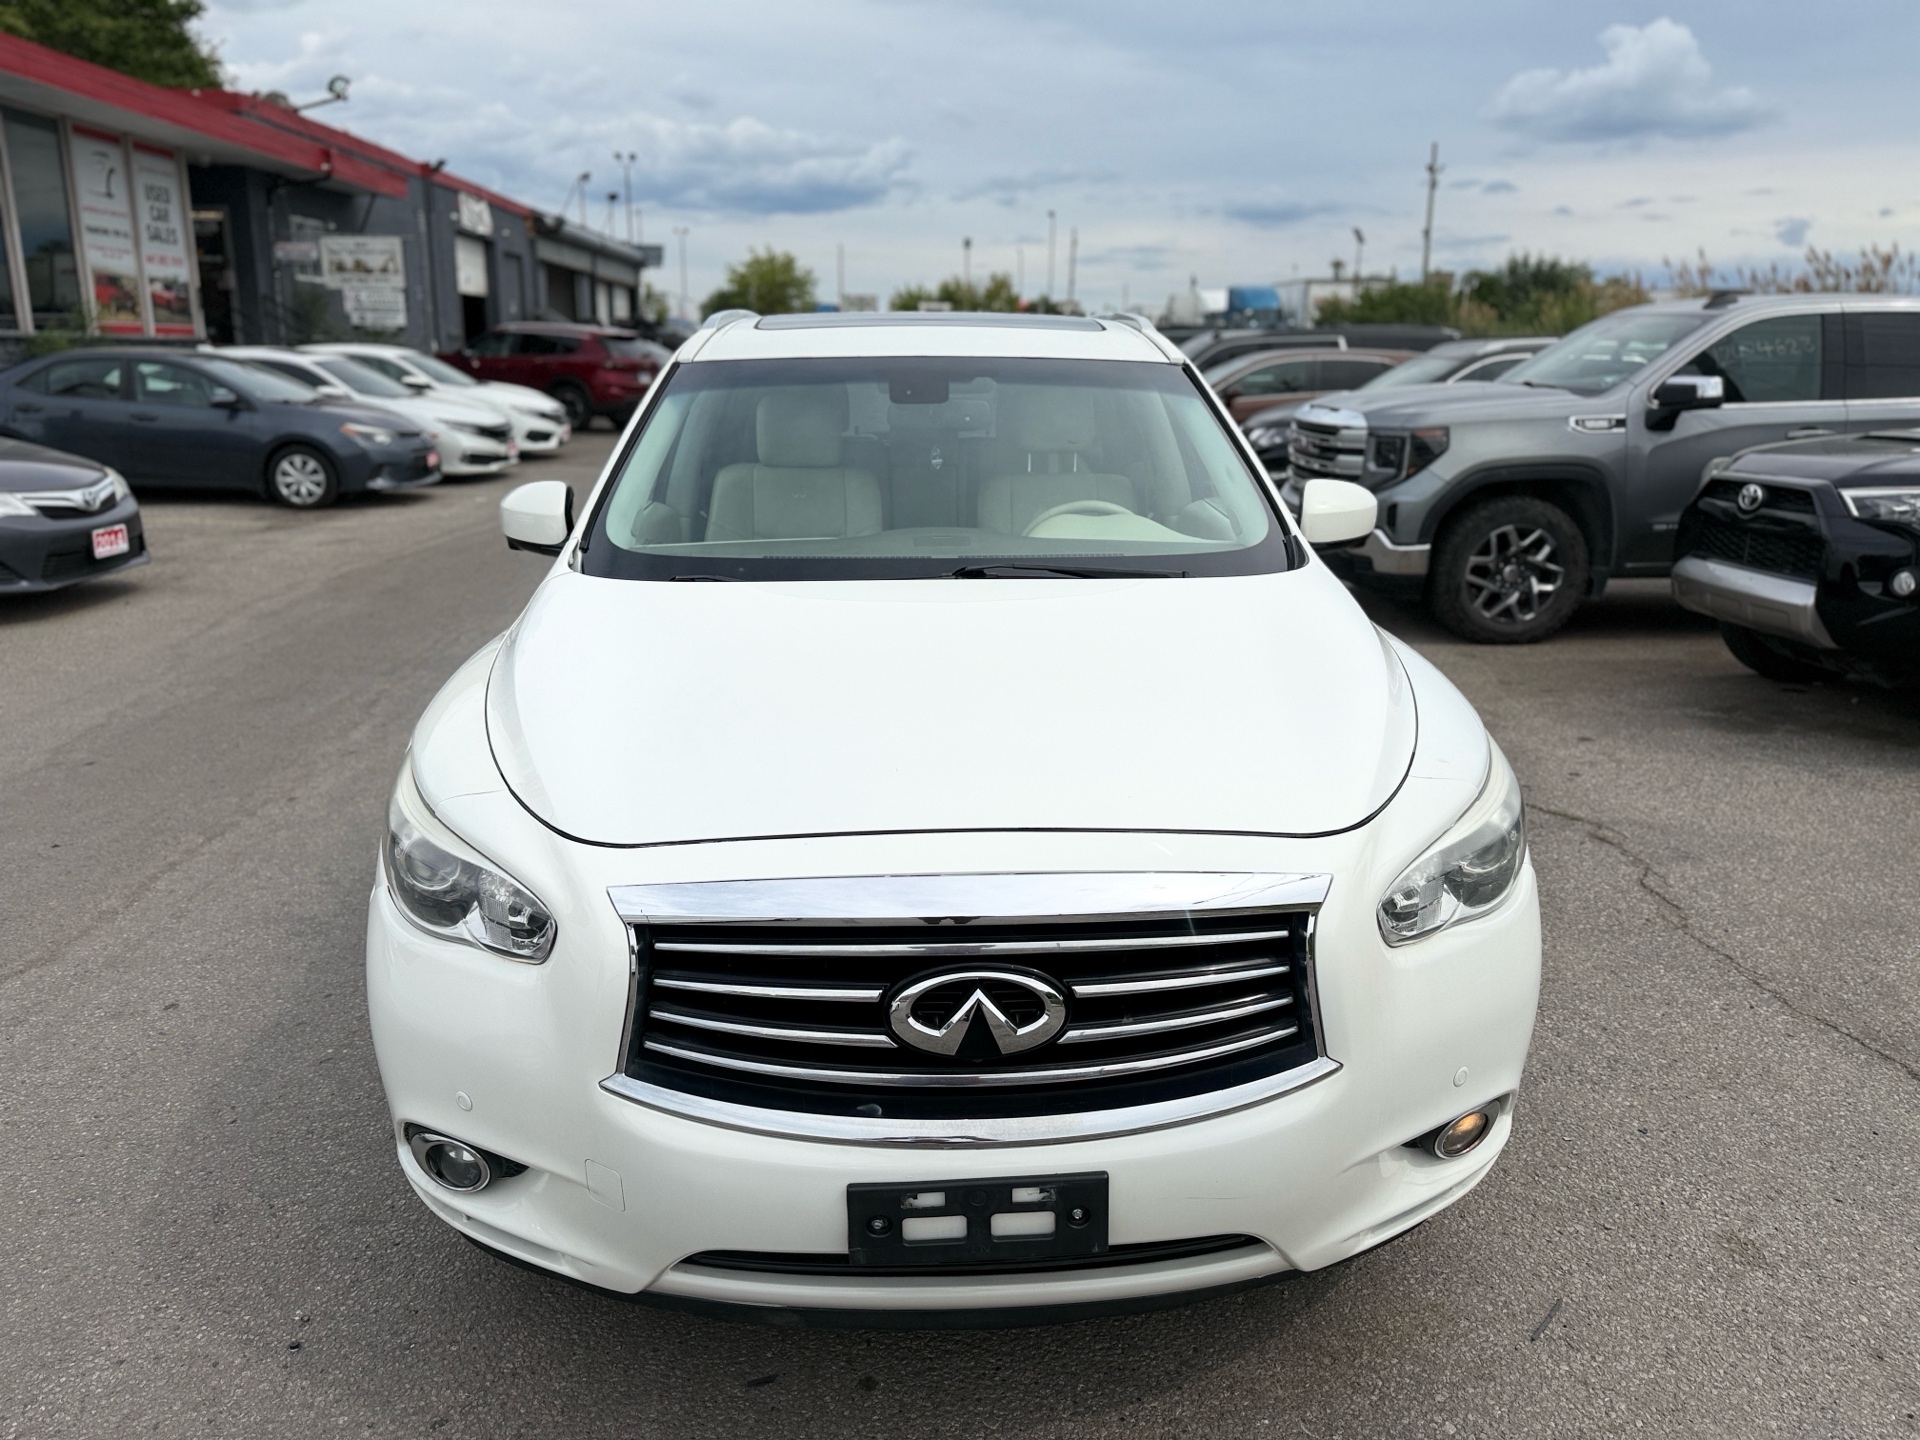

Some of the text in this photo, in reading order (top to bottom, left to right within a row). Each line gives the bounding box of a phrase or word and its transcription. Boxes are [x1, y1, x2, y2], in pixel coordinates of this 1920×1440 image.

[144, 182, 171, 204] USED
[149, 205, 170, 222] CAR
[146, 224, 178, 246] SALES
